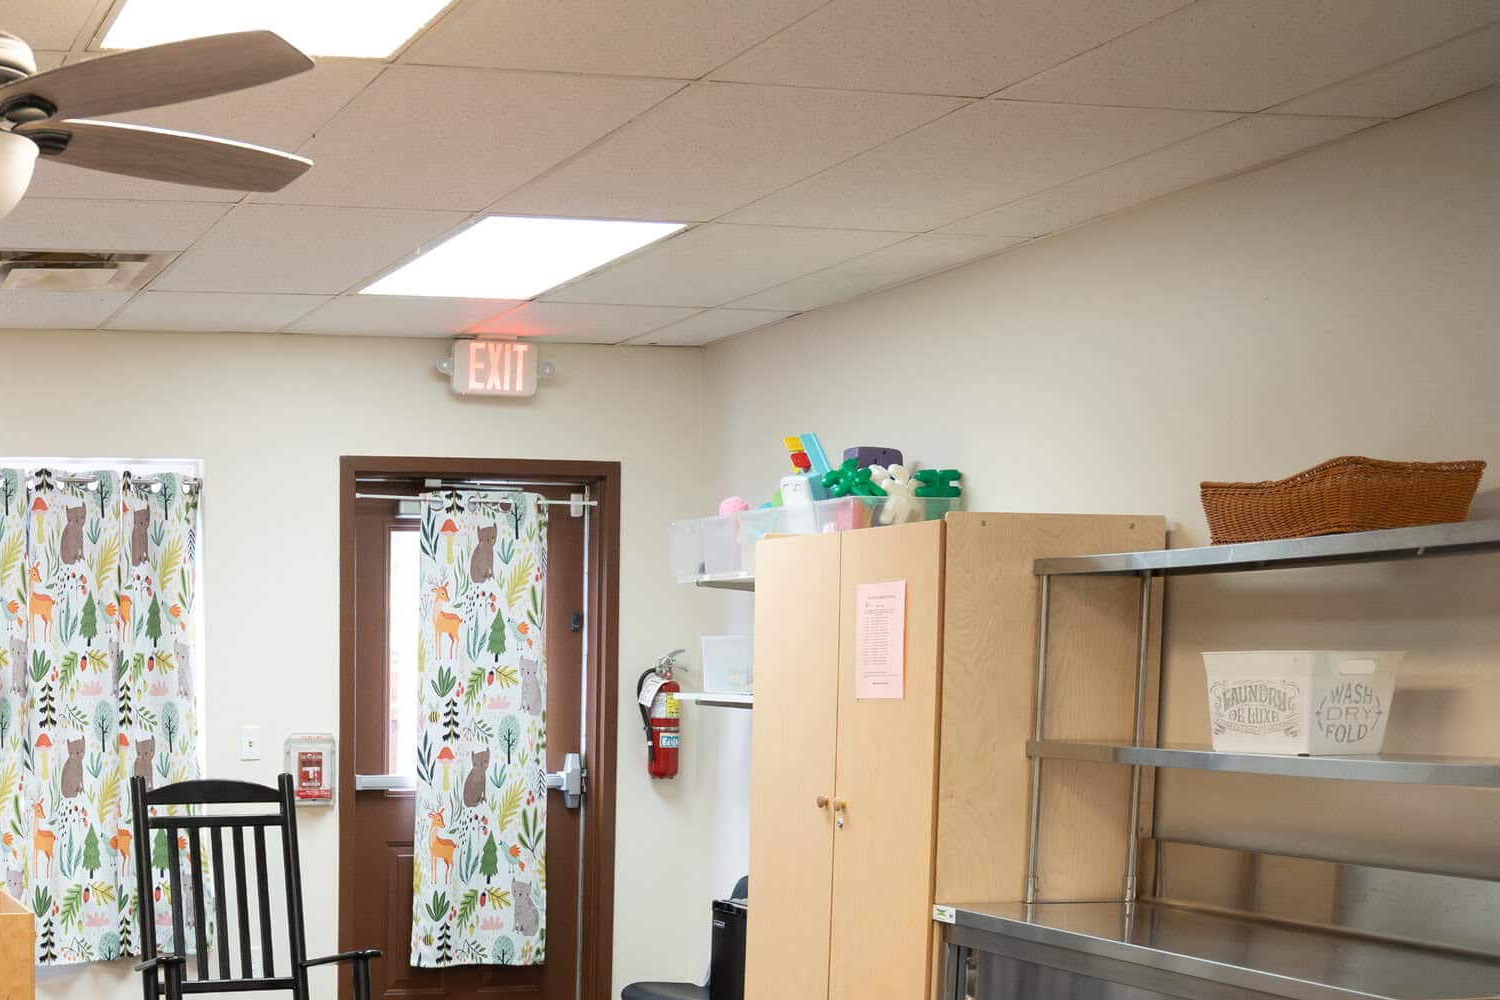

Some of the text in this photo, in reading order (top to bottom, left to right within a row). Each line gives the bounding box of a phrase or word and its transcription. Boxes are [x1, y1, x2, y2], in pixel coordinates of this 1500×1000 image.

[467, 342, 529, 392] EXIT
[1222, 684, 1287, 712] LAUNDRY
[1331, 682, 1373, 704] WASH
[1326, 706, 1373, 721] DRY
[1325, 723, 1368, 744] FOLD
